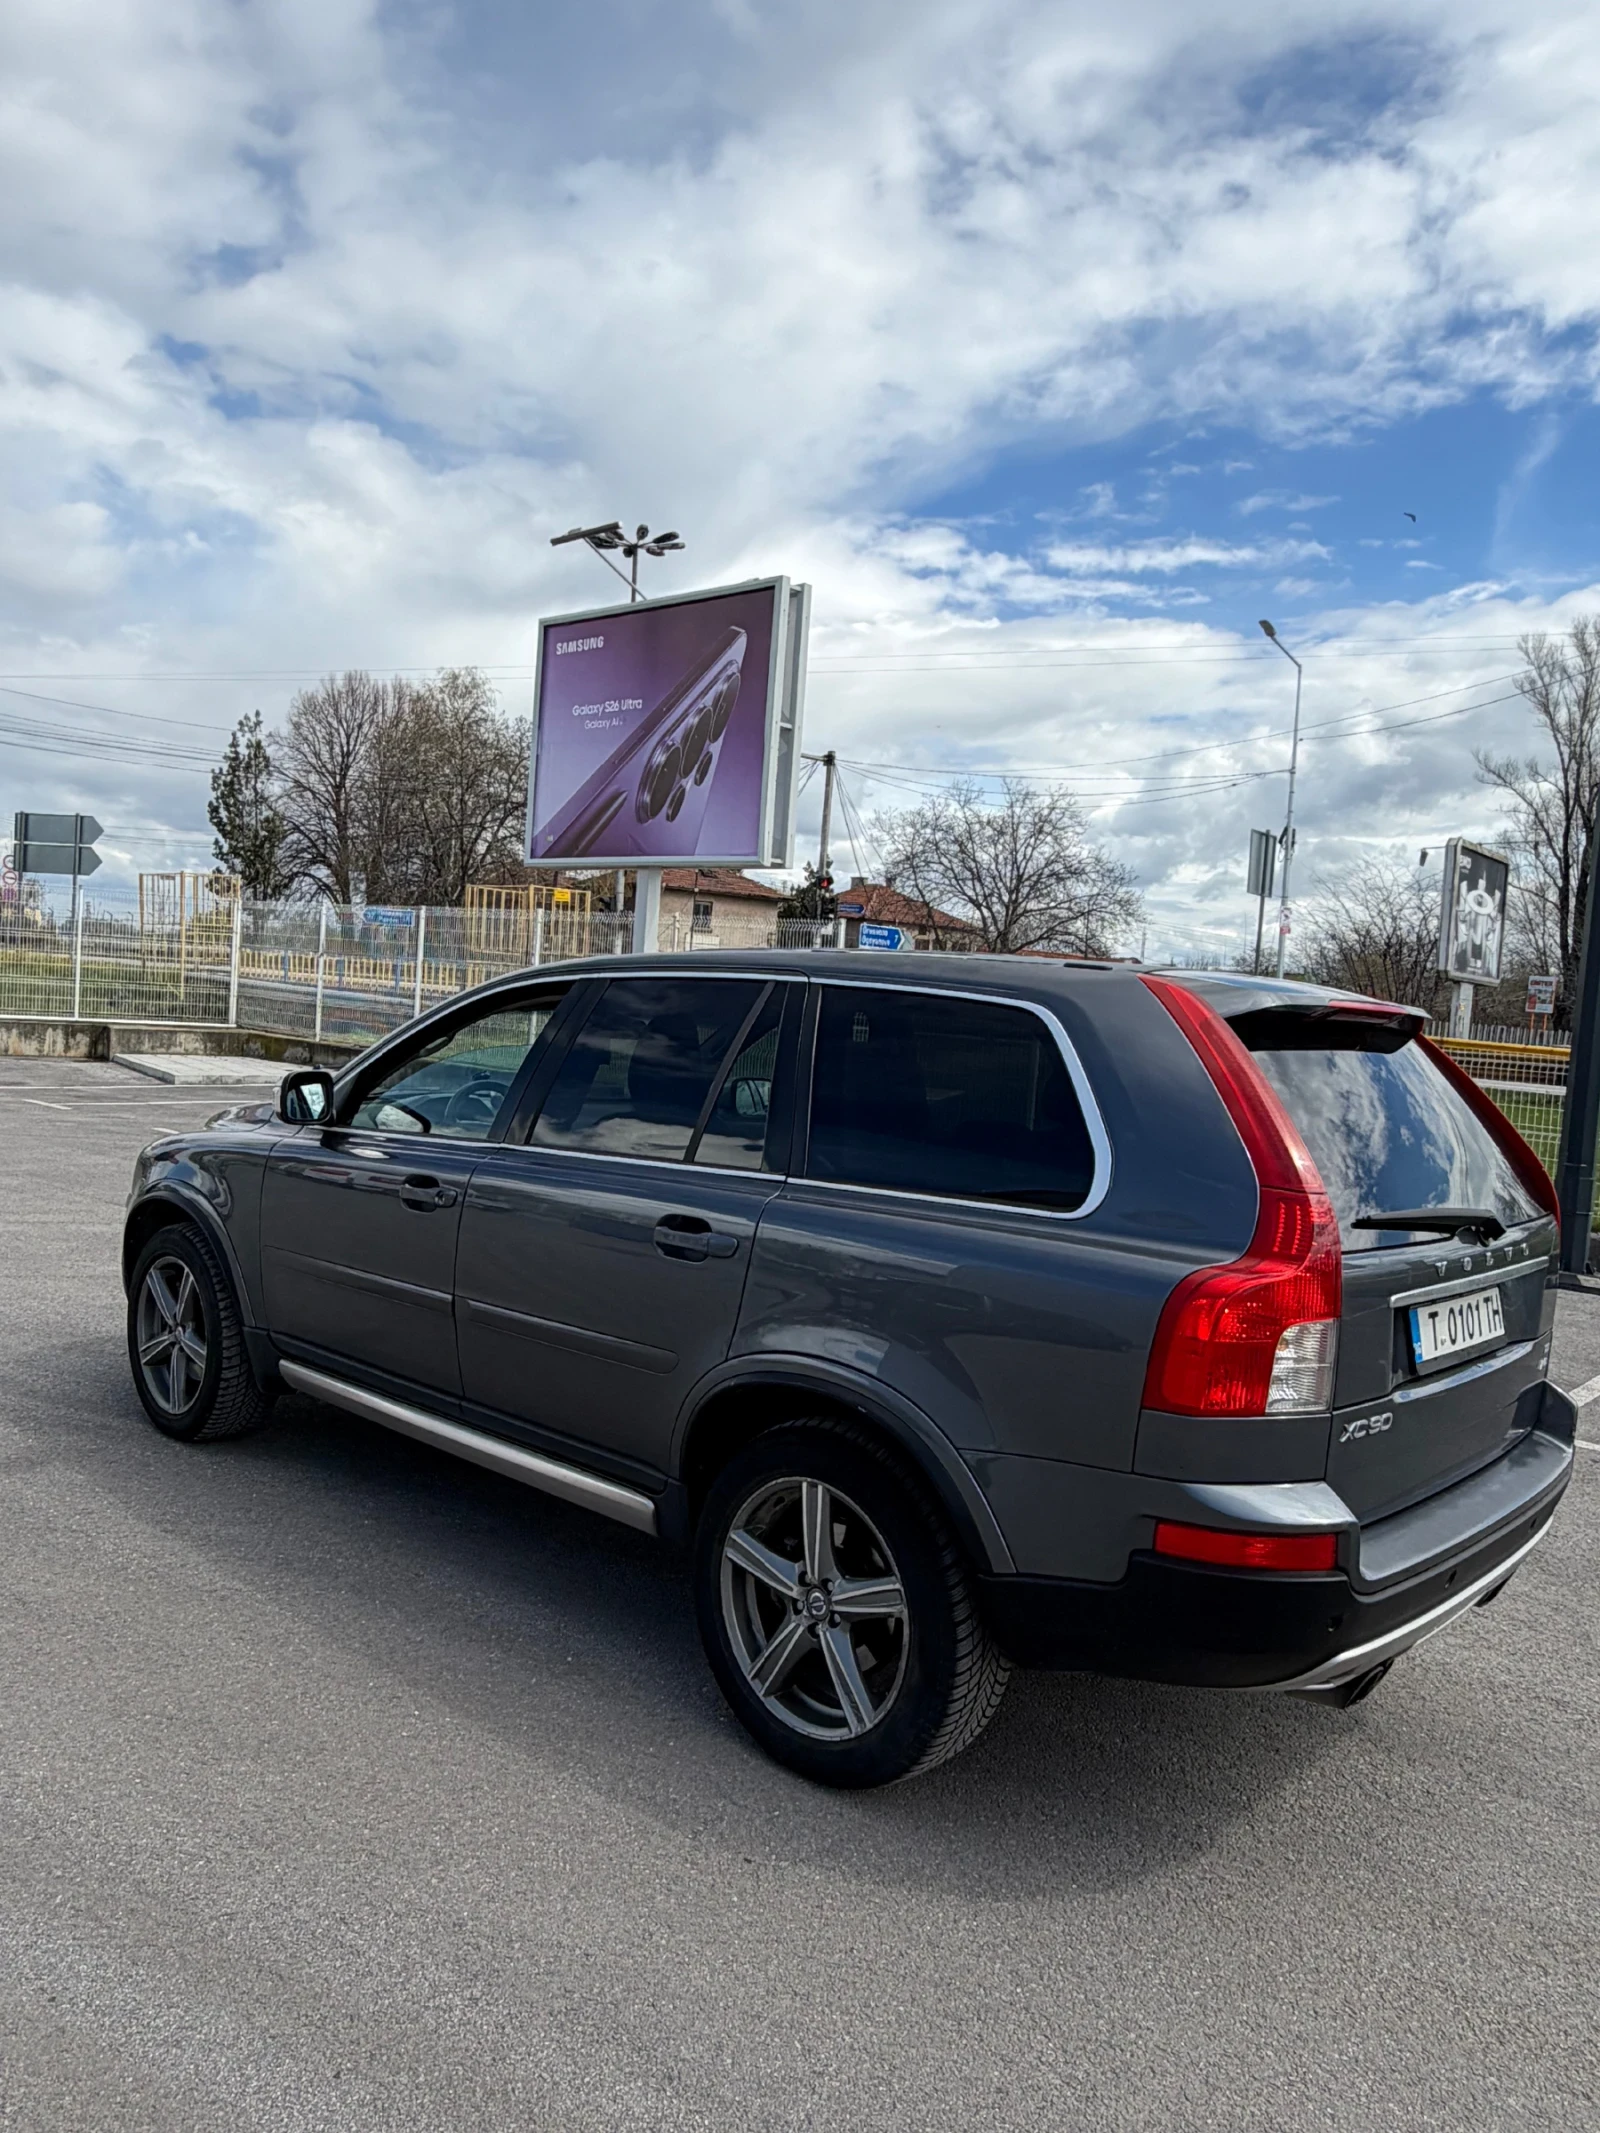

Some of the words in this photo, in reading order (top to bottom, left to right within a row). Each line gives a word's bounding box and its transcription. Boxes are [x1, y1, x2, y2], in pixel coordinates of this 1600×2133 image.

[556, 636, 604, 655] SAMSUNG
[572, 704, 604, 716] Galaxy
[604, 701, 619, 712] S26
[621, 699, 642, 710] Ultra
[584, 718, 610, 730] Galaxy
[1435, 1243, 1529, 1277] VOLVO
[1428, 1310, 1439, 1351] T
[1447, 1299, 1482, 1346] 0101
[1483, 1293, 1503, 1334] TH
[1339, 1412, 1393, 1442] XC90
